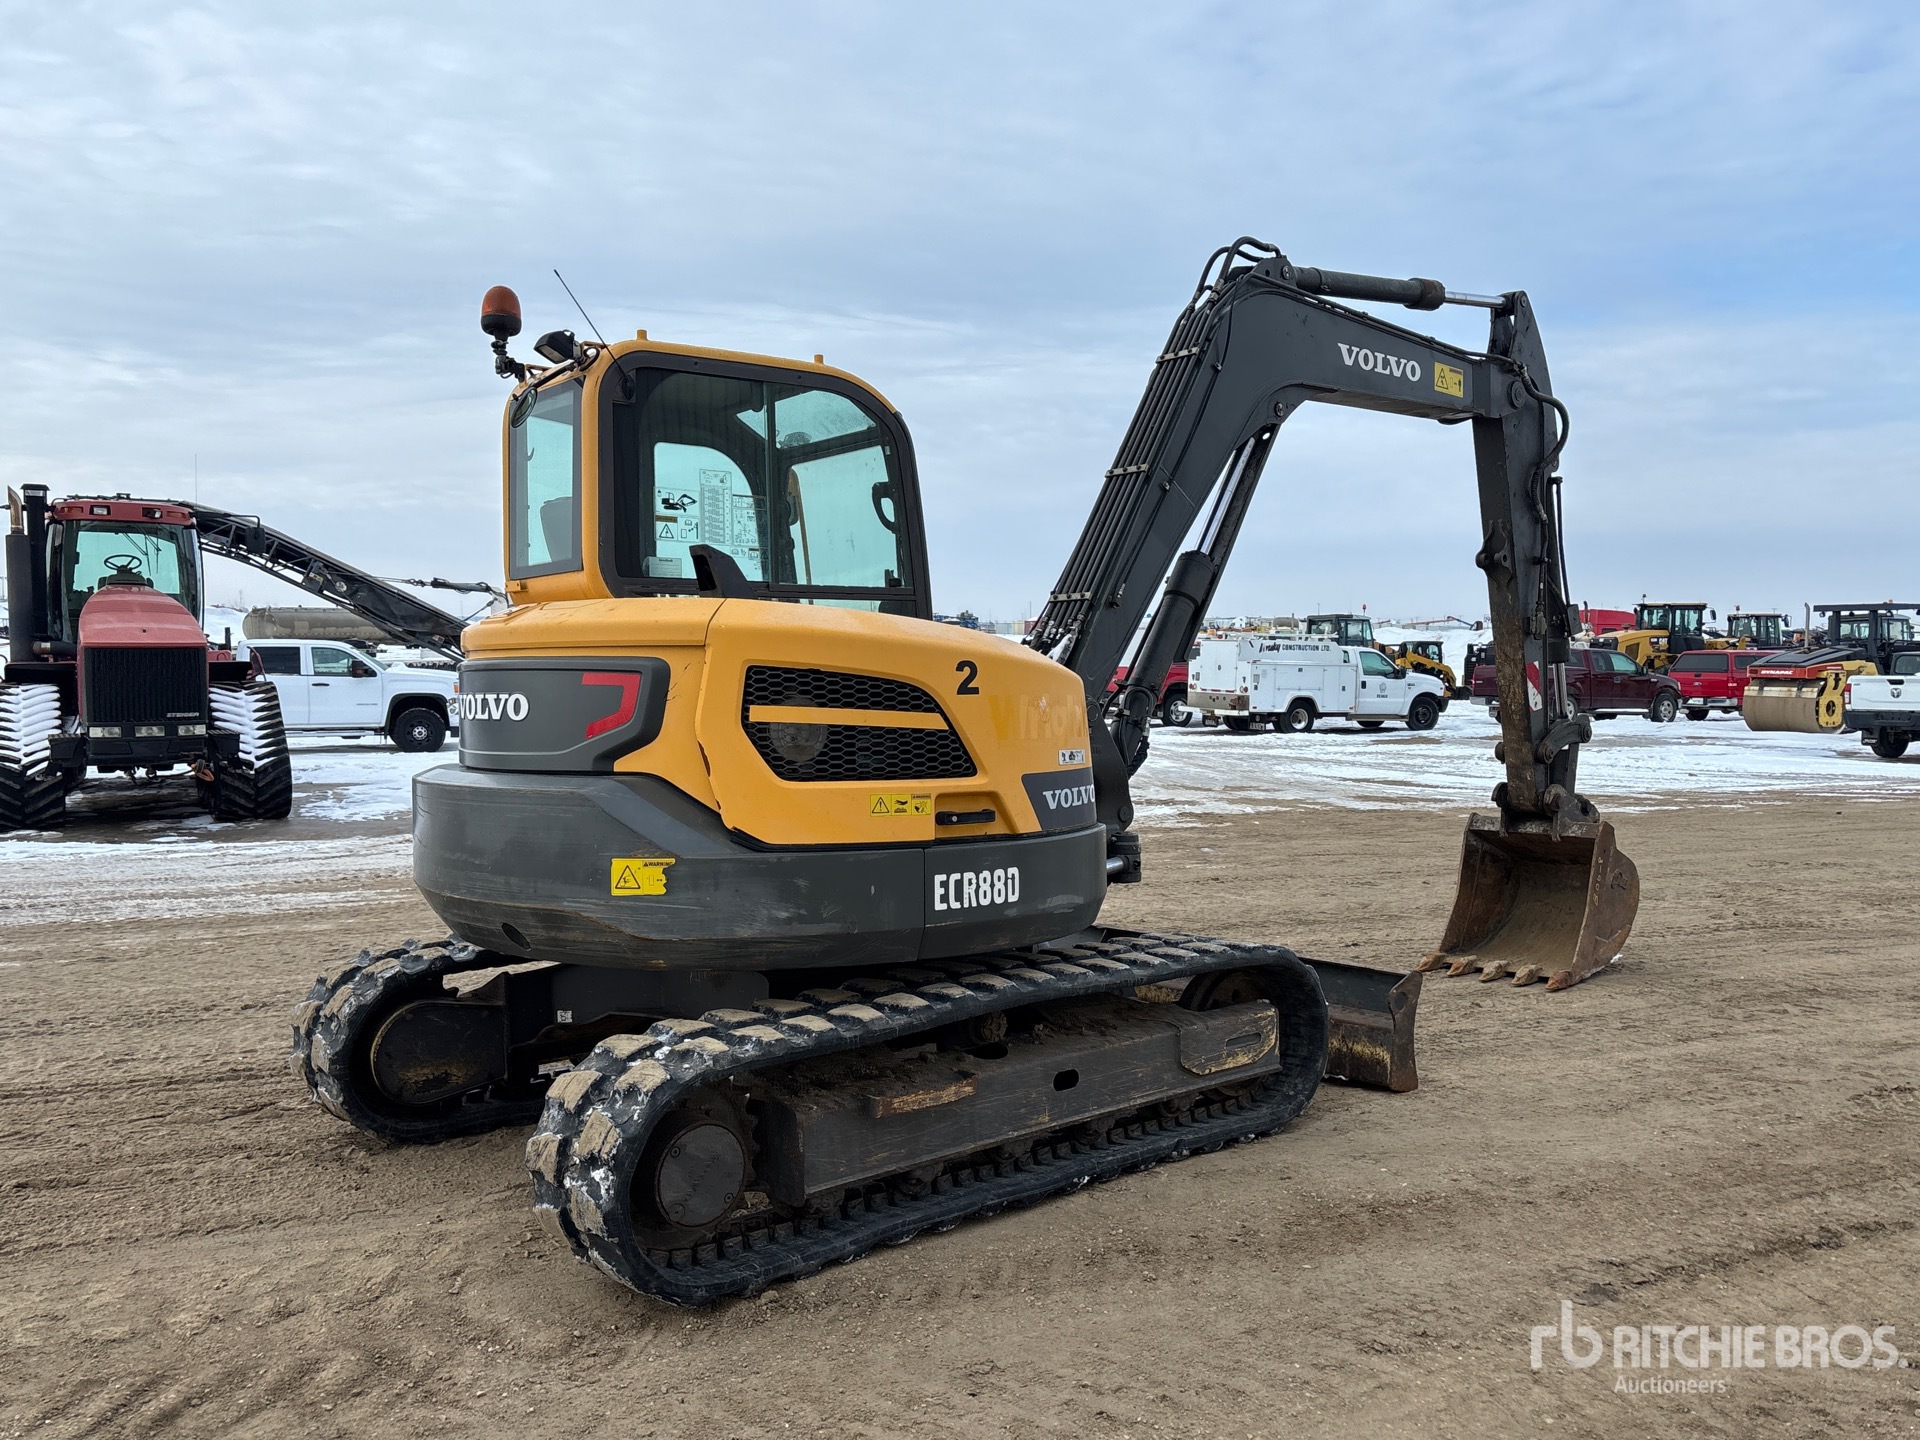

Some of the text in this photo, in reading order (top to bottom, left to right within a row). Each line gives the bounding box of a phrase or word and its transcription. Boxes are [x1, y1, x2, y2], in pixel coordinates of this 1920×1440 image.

[1338, 343, 1421, 382] VOLVO
[1282, 643, 1319, 651] CONSTRUCTION
[955, 660, 979, 695] 2
[460, 694, 529, 721] VOLVO
[1043, 784, 1095, 809] VOLVO
[935, 867, 1019, 910] ECR88D
